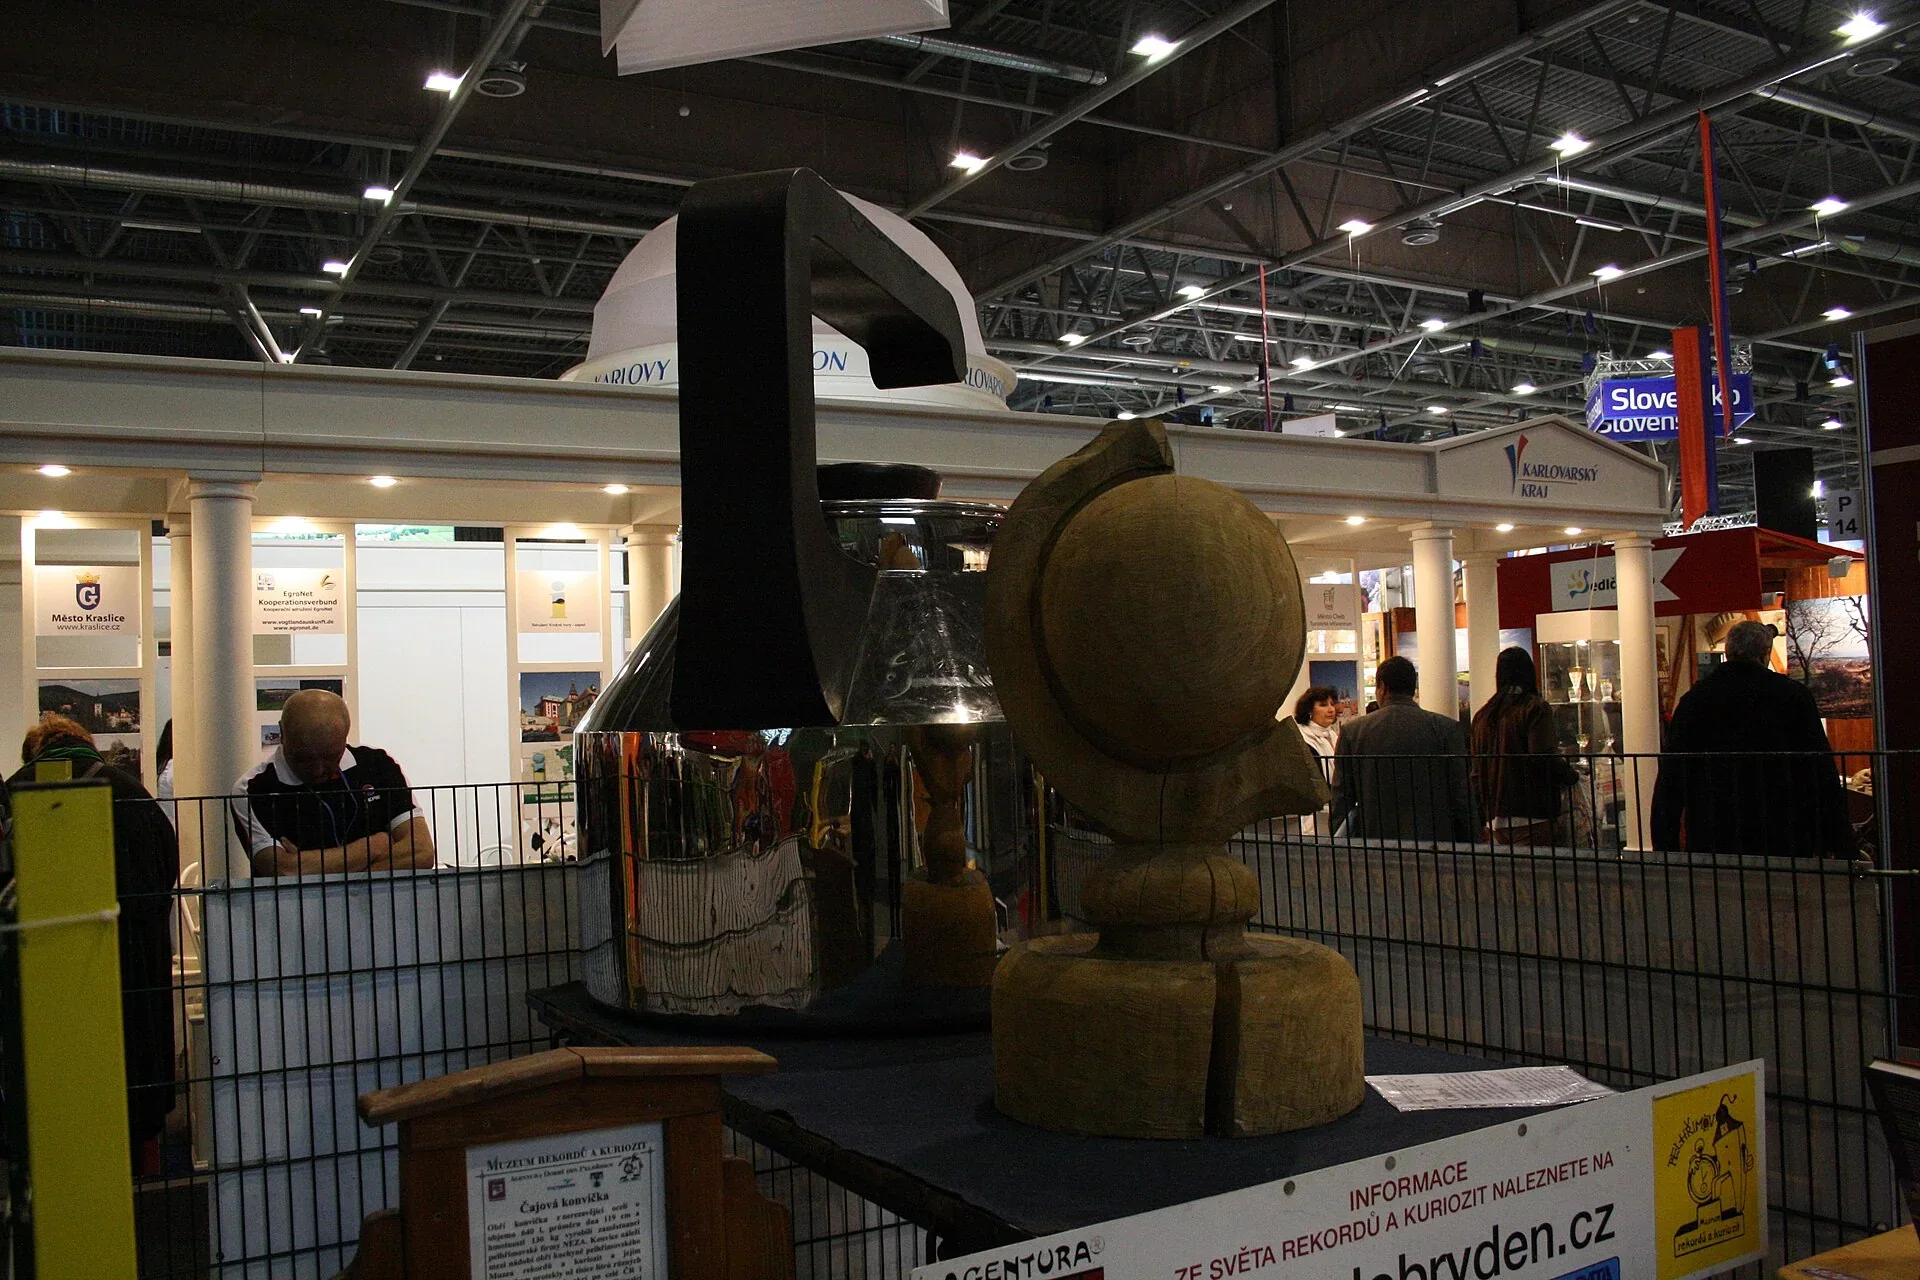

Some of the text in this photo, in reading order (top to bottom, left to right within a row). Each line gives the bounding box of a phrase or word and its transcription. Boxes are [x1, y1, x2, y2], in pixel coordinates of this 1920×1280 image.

[1611, 383, 1742, 411] Slovek
[1523, 463, 1599, 482] KARLOVARSKÝ
[1521, 484, 1548, 498] KRAJ
[1838, 496, 1852, 512] P
[1835, 518, 1858, 534] 14
[283, 590, 313, 598] EgroNet
[51, 613, 125, 622] Město Kraslice
[262, 619, 335, 627] www.vogtlandauskunft.de
[56, 623, 121, 631] www.kraslice.cz
[486, 1156, 535, 1171] MUZEUM
[538, 1146, 587, 1165] REKORDŮ
[600, 1142, 646, 1156] KURIOZIT
[1349, 1160, 1469, 1212] INFORMACE
[520, 1192, 609, 1213] Čajová konvička
[1209, 1246, 1277, 1280] SVĚTA
[1282, 1210, 1380, 1260] REKORDŮ
[1385, 1213, 1399, 1233] A
[1404, 1184, 1489, 1228] KURIOZIT
[1492, 1158, 1589, 1202] NALEZNETE
[1593, 1150, 1615, 1173] NA
[1352, 1202, 1616, 1280] bryden.cz
